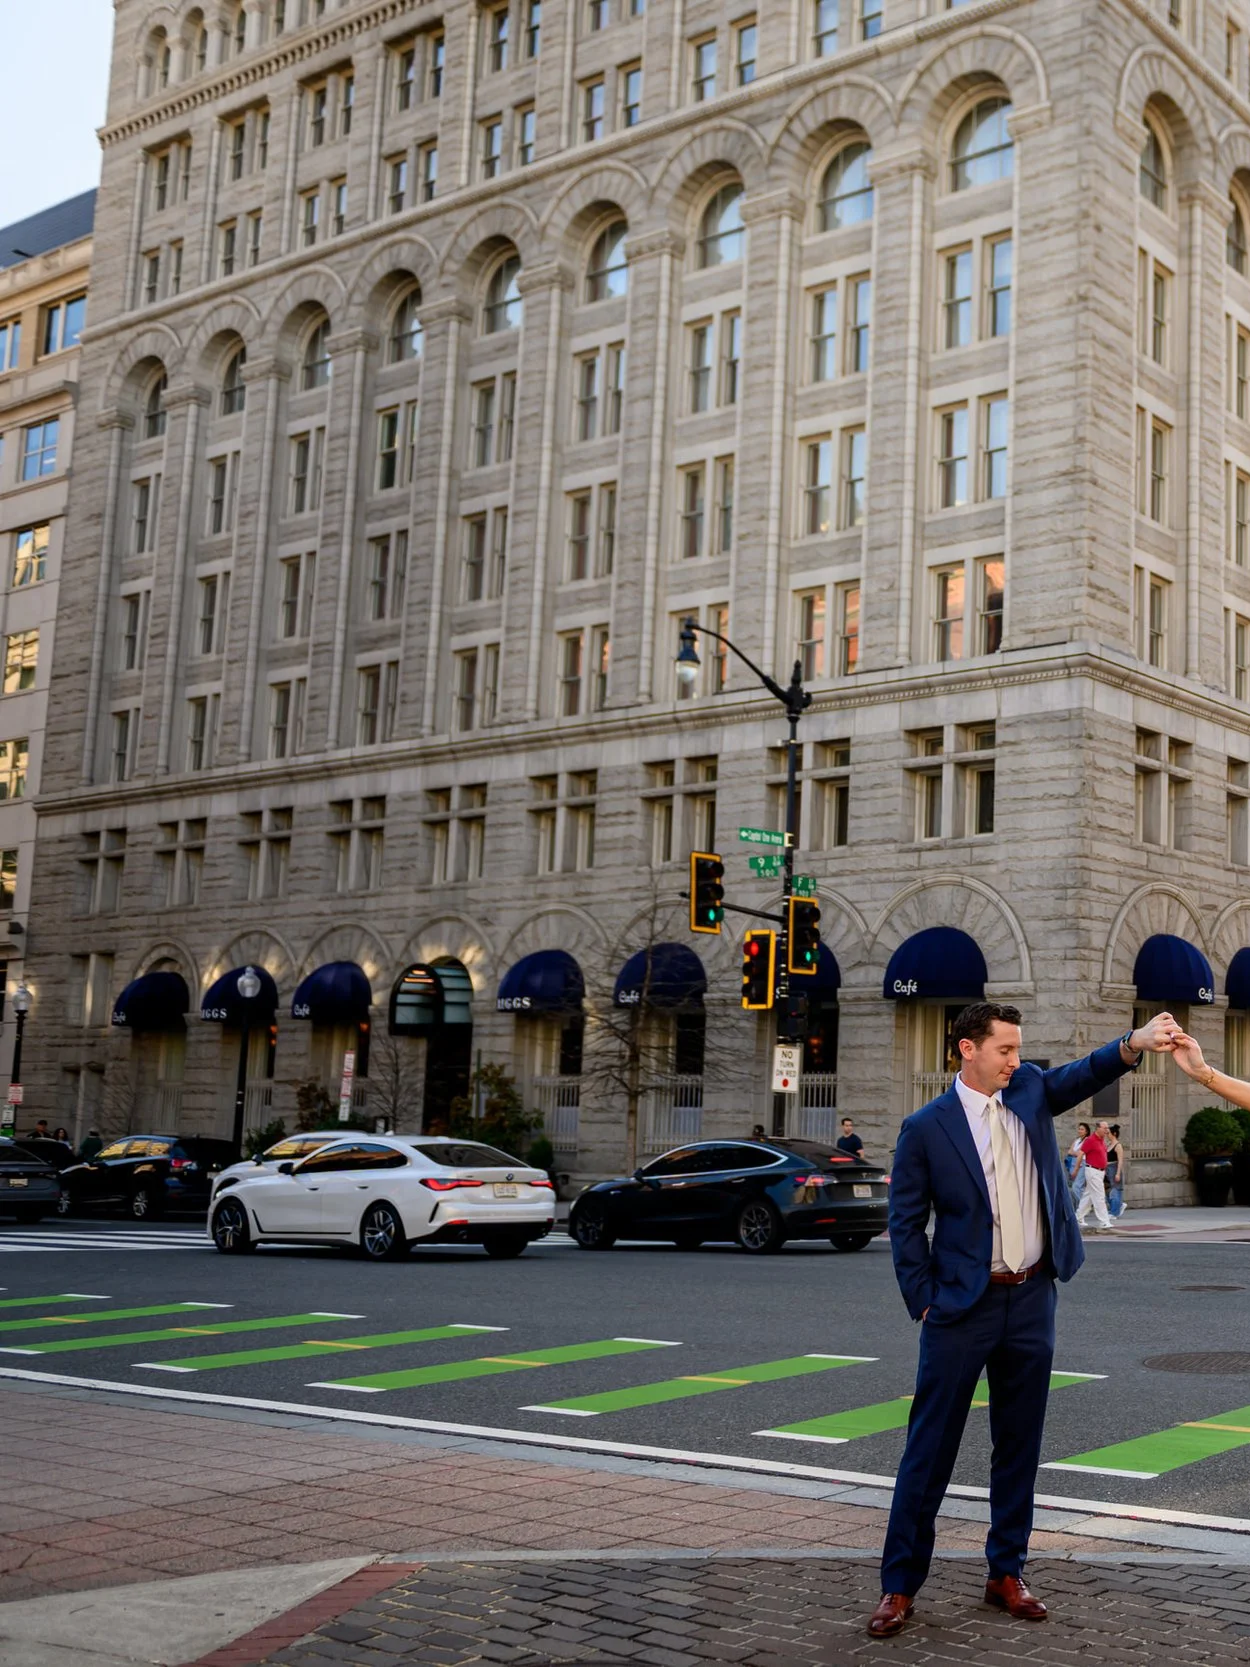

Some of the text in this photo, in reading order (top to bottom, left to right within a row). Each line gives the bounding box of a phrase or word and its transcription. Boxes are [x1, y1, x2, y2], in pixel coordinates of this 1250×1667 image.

[757, 857, 765, 868] 9
[797, 876, 803, 887] F
[893, 979, 918, 996] Café
[781, 1050, 793, 1060] NO
[779, 1060, 795, 1069] TURN
